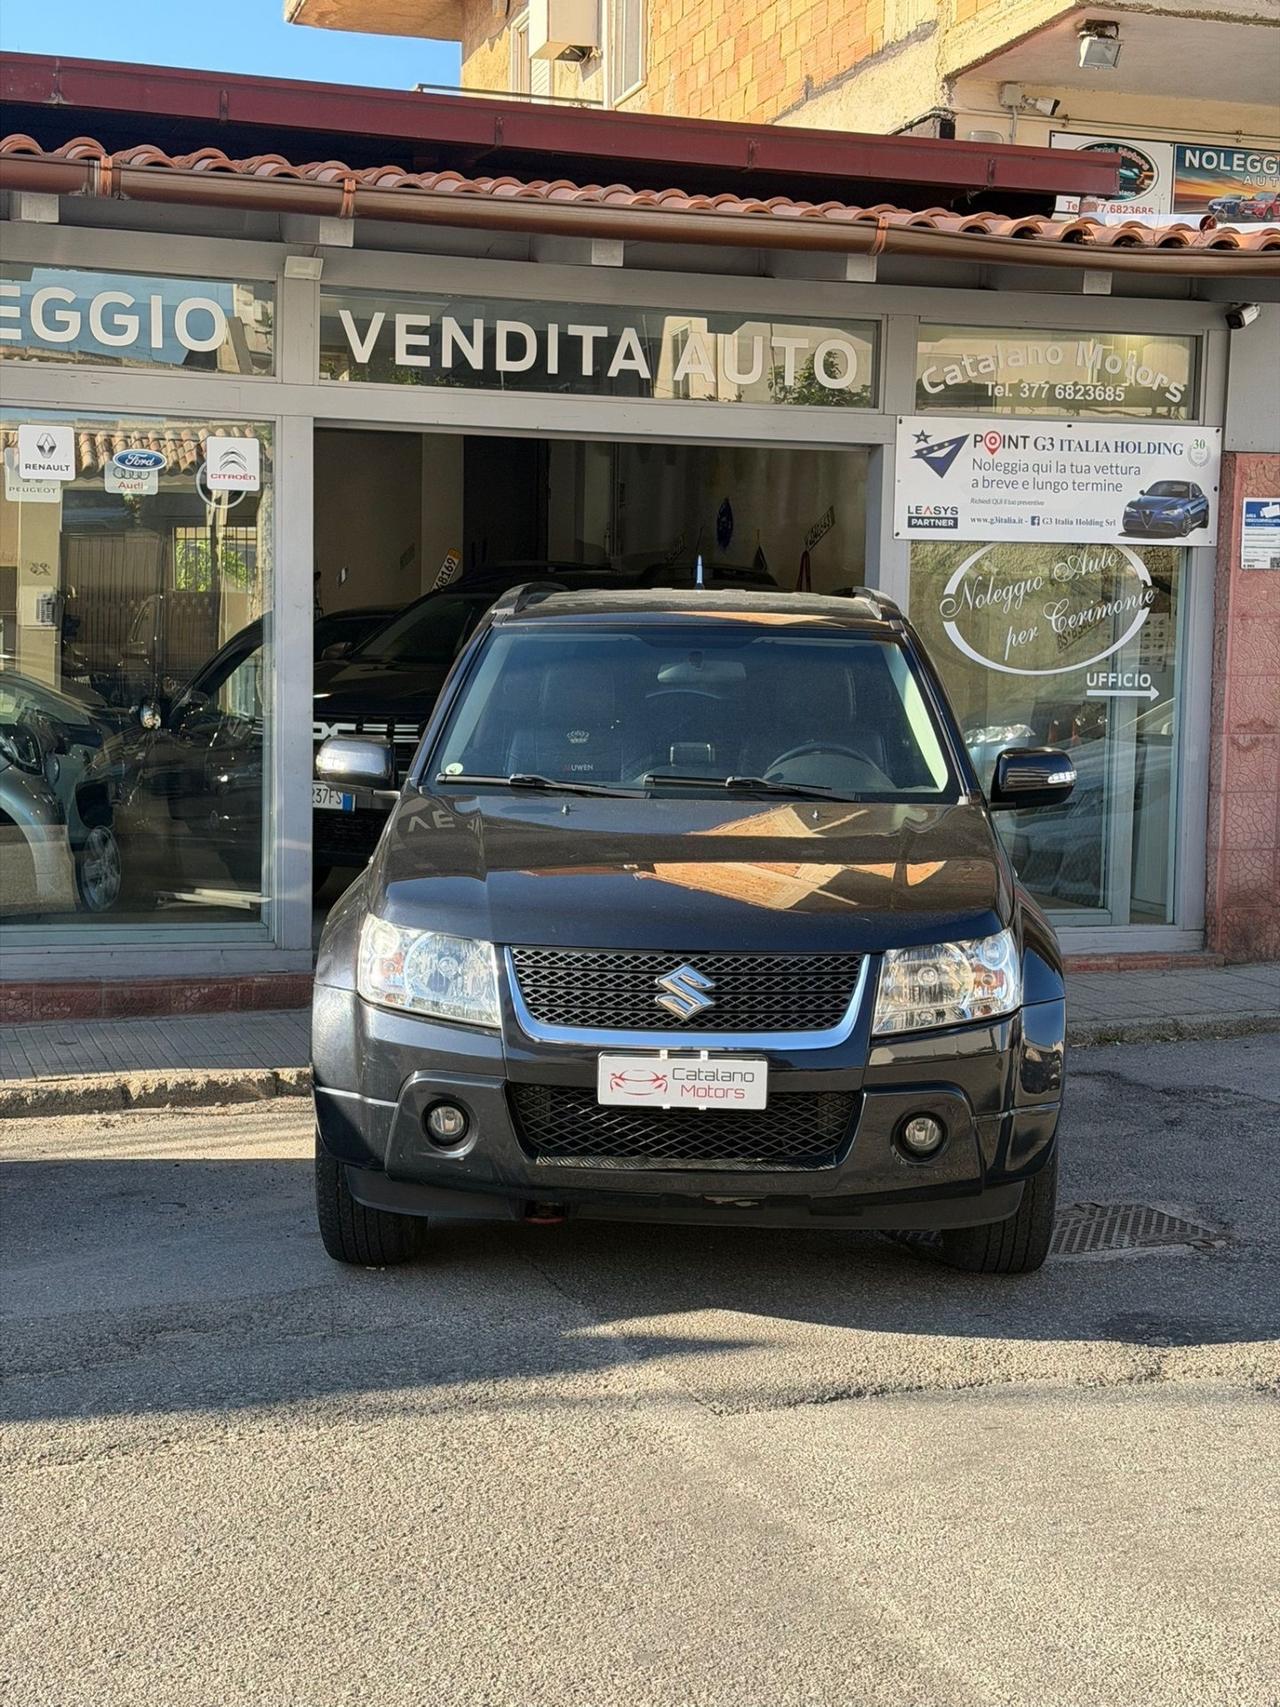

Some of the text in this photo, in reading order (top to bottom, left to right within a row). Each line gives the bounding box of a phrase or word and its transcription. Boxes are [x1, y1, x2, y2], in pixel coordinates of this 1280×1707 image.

[1185, 149, 1278, 175] NOLEGG
[1243, 175, 1280, 188] AUT
[1066, 201, 1079, 211] Te
[338, 309, 859, 389] VENDITA AUTO
[921, 340, 1186, 403] Catalano Motors
[985, 382, 1125, 402] Tel. 377 6823685
[973, 431, 1031, 455] POINT
[1033, 436, 1055, 452] G3
[1059, 438, 1114, 454] ITALIA
[1114, 440, 1184, 456] HOLDING
[1193, 439, 1206, 449] 30
[25, 463, 71, 472] RENAULT
[125, 453, 155, 467] Ford
[972, 458, 1141, 476] Noleggia qui la tua vettura
[9, 486, 58, 495] PEUGEOT
[117, 481, 144, 491] Audi
[971, 476, 1123, 493] a breve e lungo termine
[908, 505, 959, 516] LEASYS
[911, 517, 955, 527] PARTNER
[970, 515, 1023, 526] www.g3italia.it
[1042, 517, 1053, 525] G3
[1055, 518, 1074, 526] Italia
[1075, 518, 1104, 528] Holding
[1105, 518, 1117, 527] Srl
[939, 549, 1119, 619] Noleggio Auto
[1004, 626, 1040, 661] per
[1043, 584, 1155, 633] Cerimonie
[1086, 672, 1152, 688] UFFICIO
[672, 1067, 755, 1083] Catalano
[680, 1084, 746, 1100] Motors
